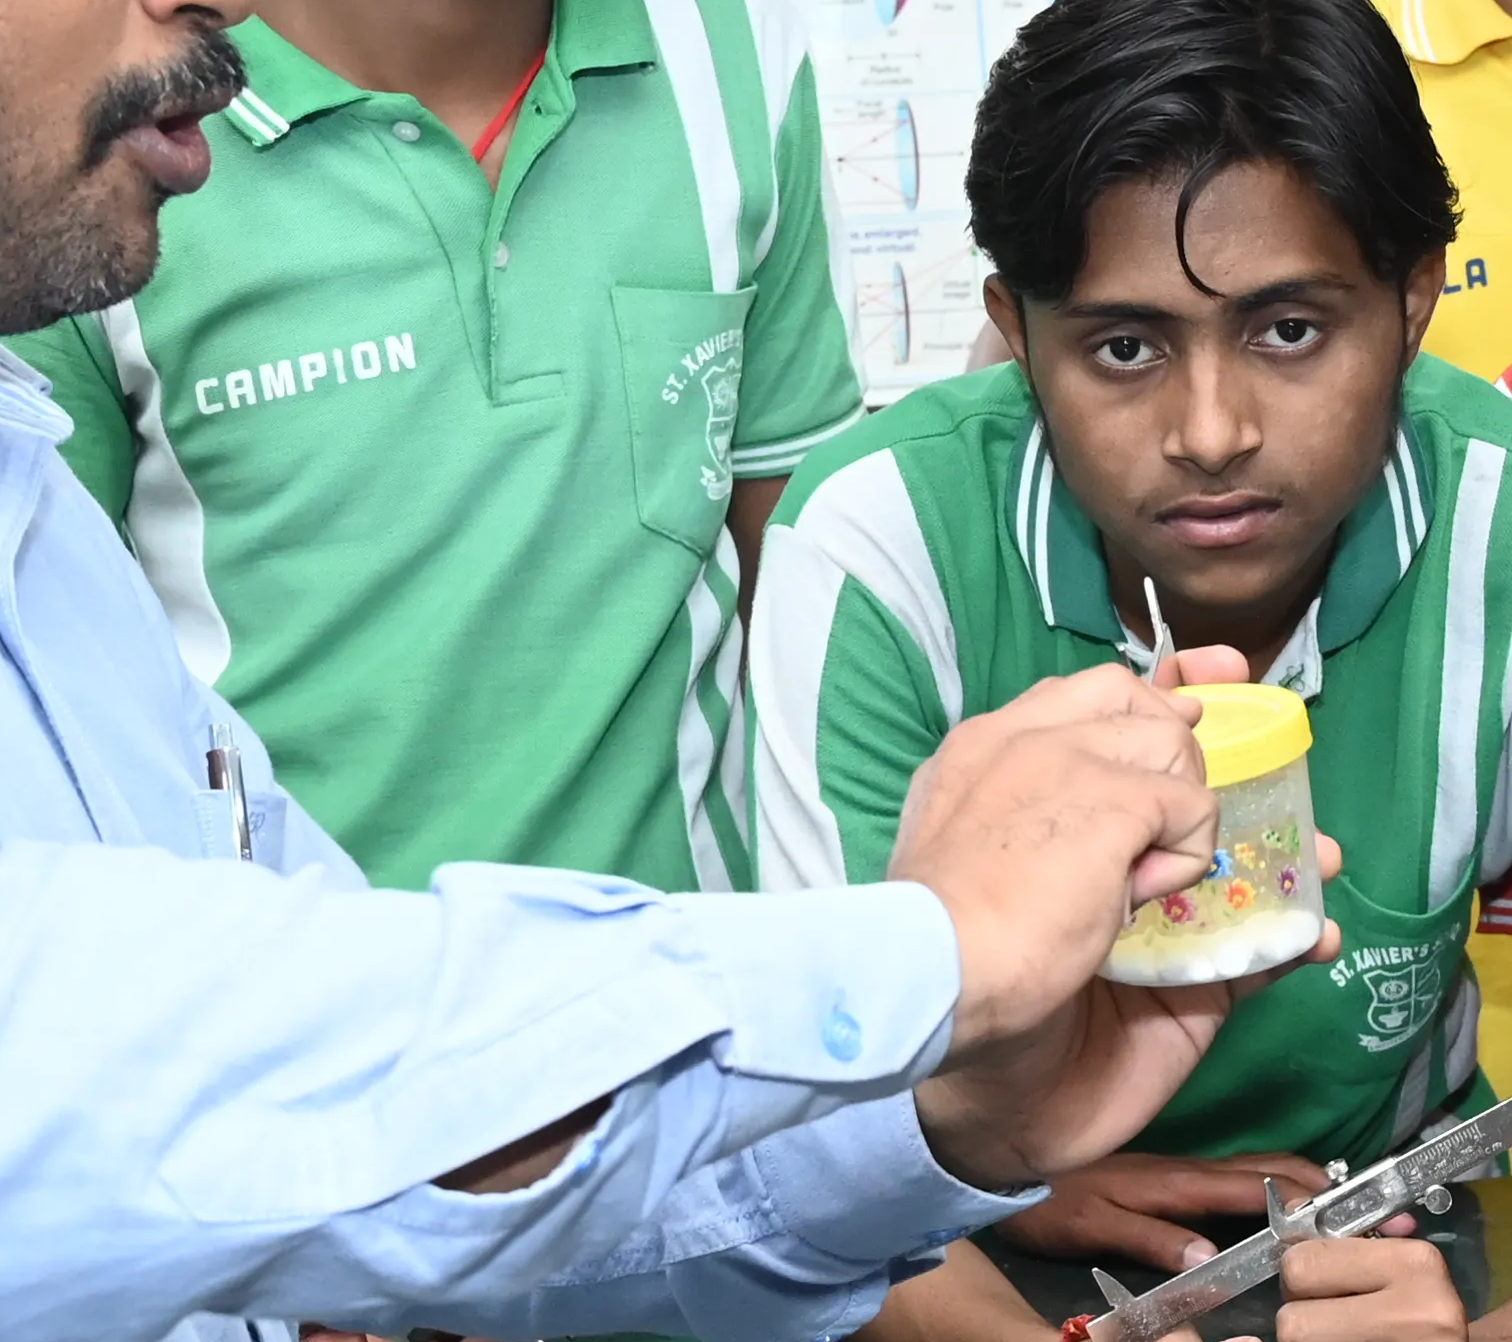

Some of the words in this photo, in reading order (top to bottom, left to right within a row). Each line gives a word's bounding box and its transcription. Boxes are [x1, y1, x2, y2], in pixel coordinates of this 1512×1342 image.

[194, 333, 416, 415] CAMPION
[661, 372, 688, 405] ST.
[1329, 958, 1355, 988] ST.
[1352, 943, 1430, 973] XAVIER'S
